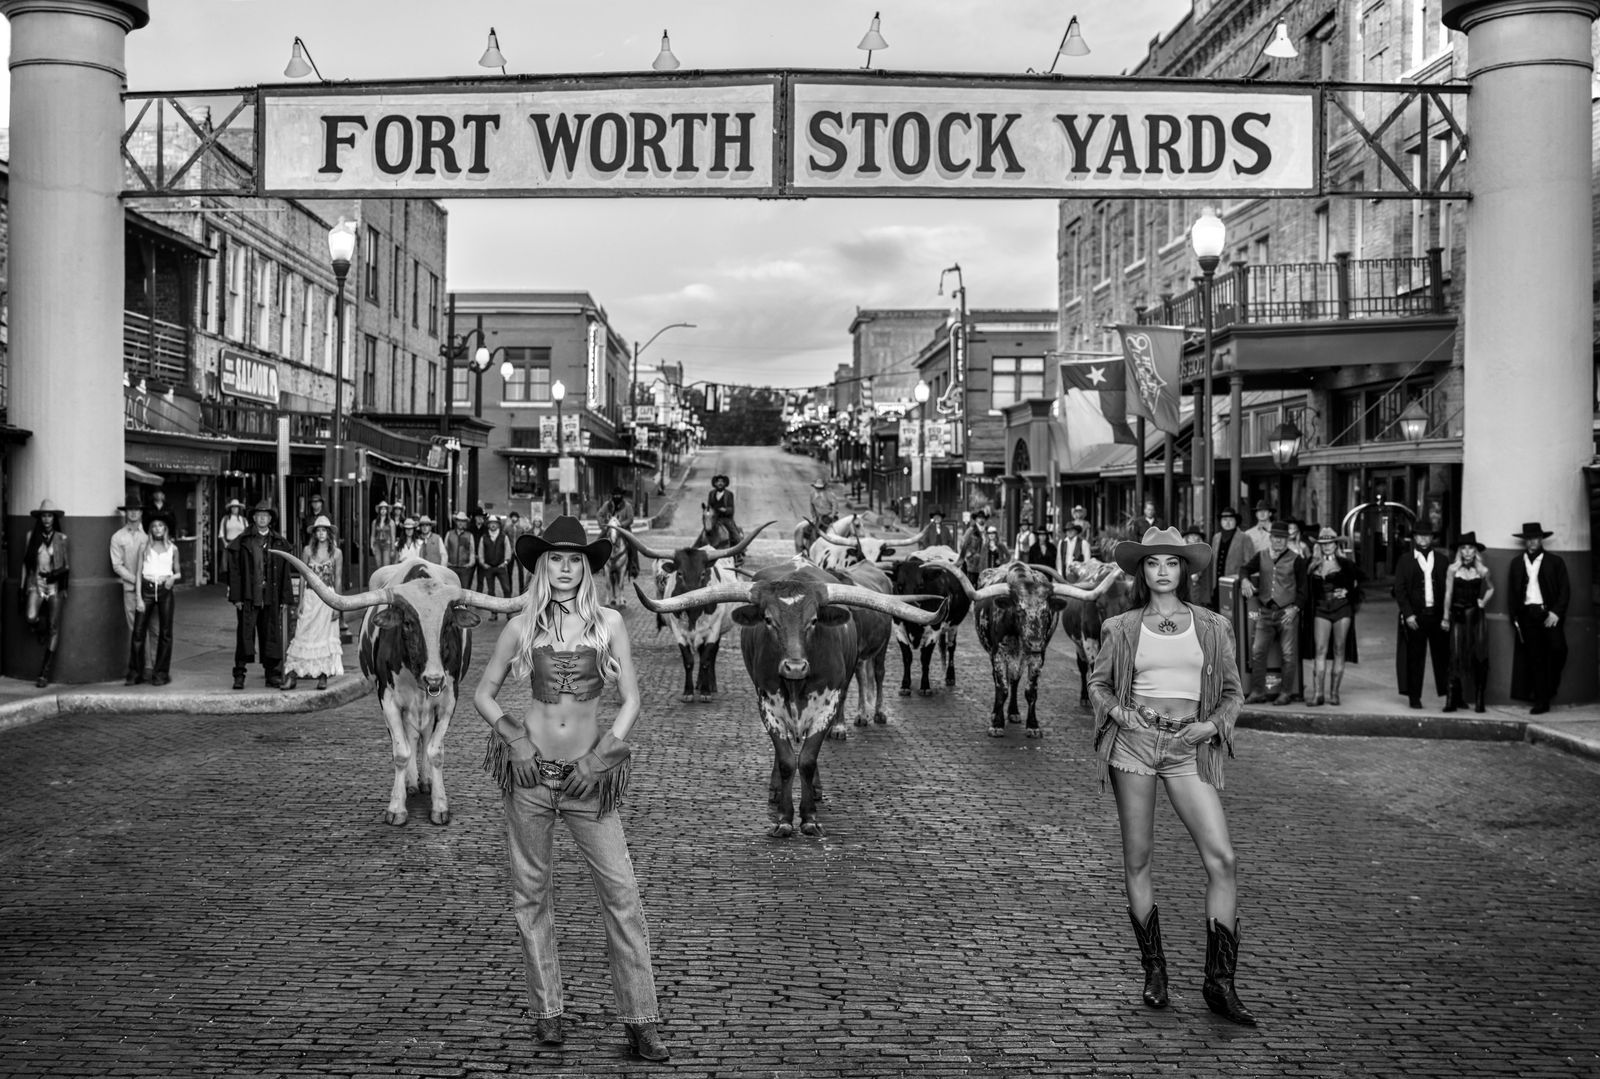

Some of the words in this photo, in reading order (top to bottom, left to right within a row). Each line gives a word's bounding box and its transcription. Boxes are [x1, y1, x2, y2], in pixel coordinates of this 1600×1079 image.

[317, 114, 501, 176] FORT
[527, 112, 756, 175] WORTH
[807, 110, 1026, 176] STOCK
[1055, 111, 1273, 176] YARDS
[235, 357, 269, 397] SALOON
